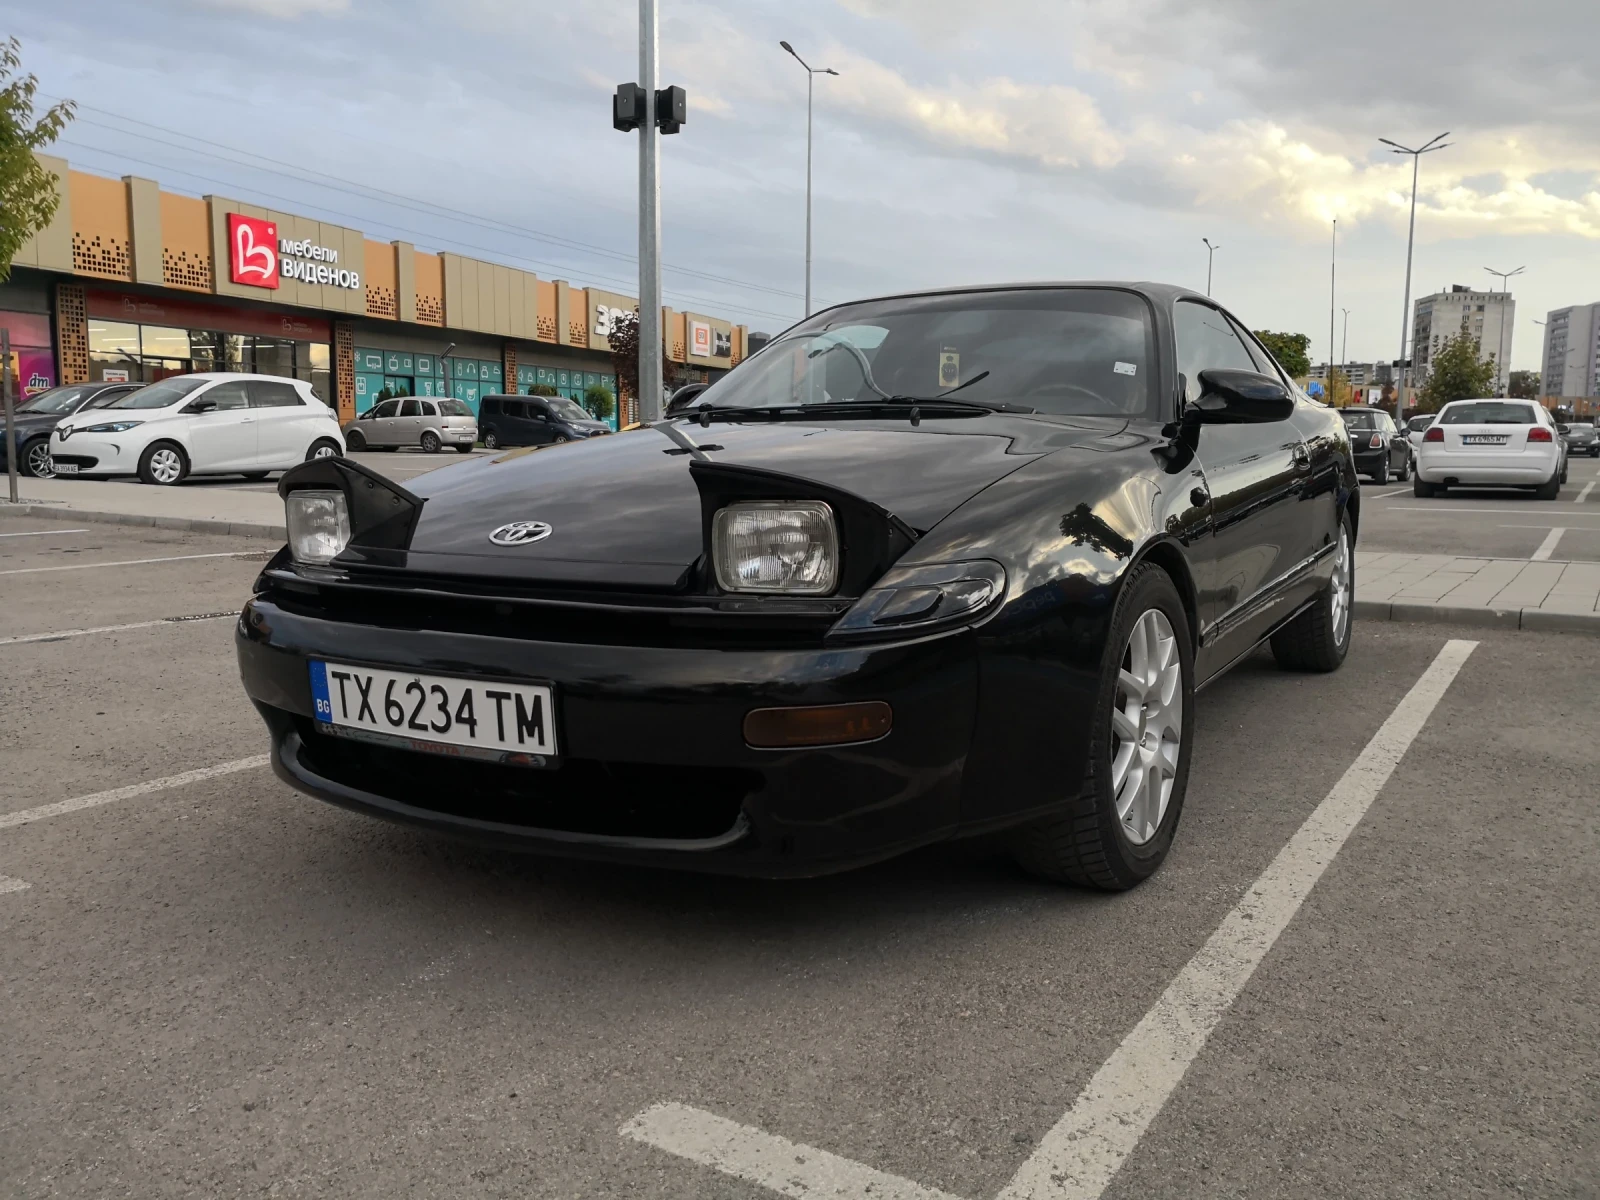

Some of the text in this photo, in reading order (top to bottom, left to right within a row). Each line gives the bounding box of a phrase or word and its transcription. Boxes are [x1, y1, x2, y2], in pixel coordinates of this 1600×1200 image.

[281, 239, 338, 263] мебели
[29, 373, 49, 387] dm
[316, 699, 330, 714] BG
[331, 671, 546, 746] TX 6234 TM
